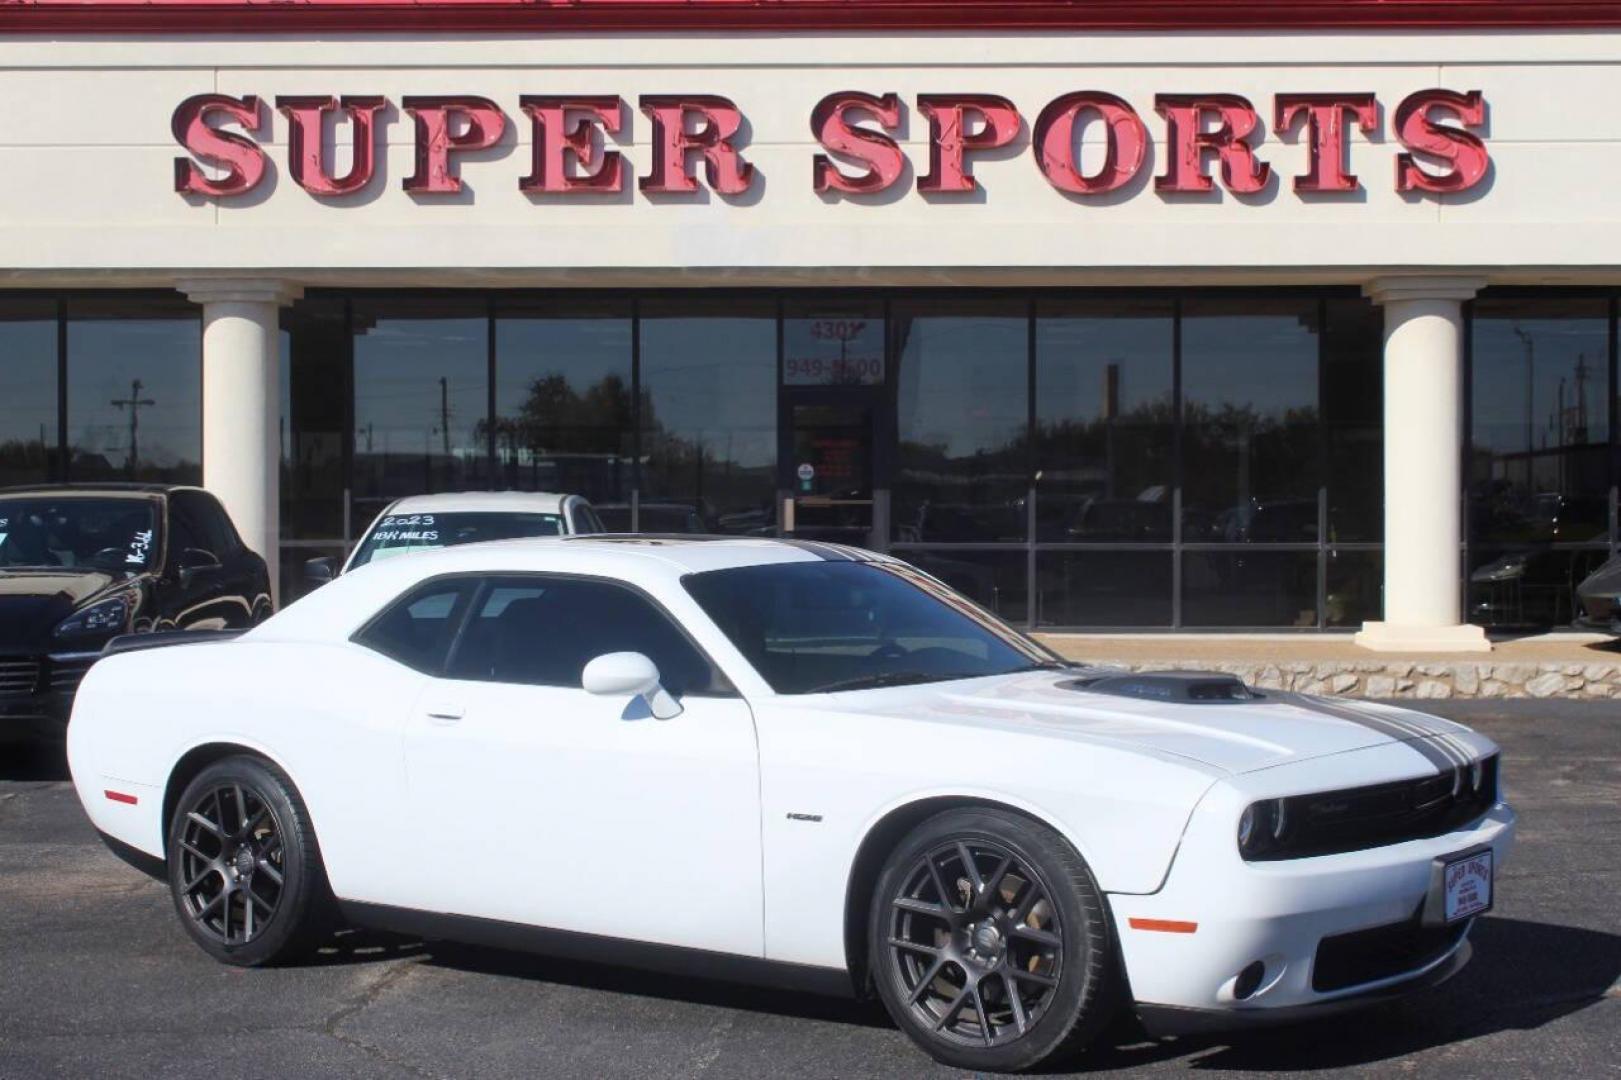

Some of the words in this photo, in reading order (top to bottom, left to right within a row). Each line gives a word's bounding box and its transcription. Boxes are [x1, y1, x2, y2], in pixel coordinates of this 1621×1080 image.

[171, 93, 754, 196] SUPER
[809, 89, 1488, 195] SPORTS
[380, 515, 434, 527] 2023
[399, 530, 439, 540] MILES
